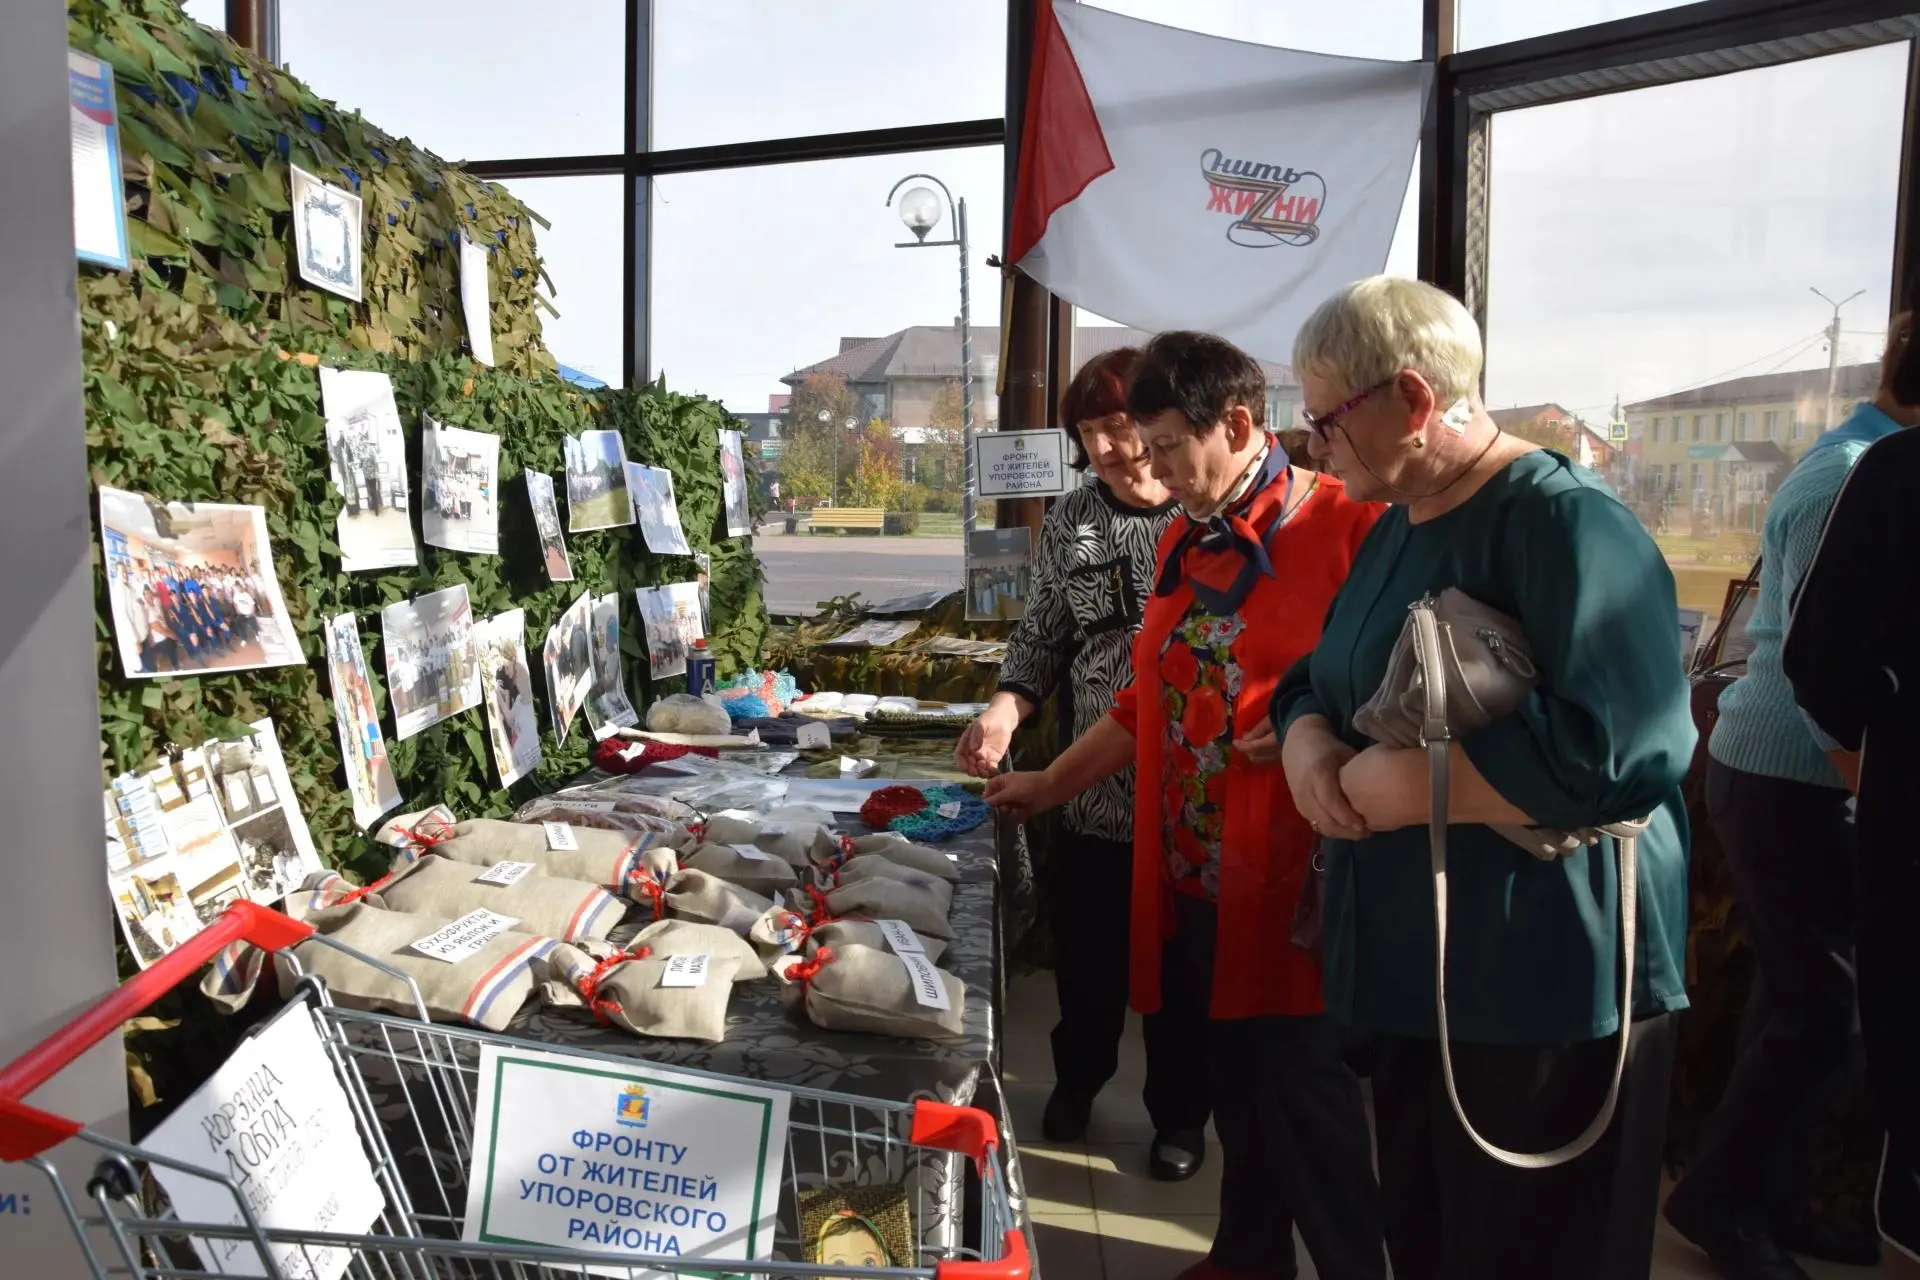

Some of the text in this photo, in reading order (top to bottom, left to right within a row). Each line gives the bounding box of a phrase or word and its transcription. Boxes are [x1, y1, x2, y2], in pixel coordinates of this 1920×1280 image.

[993, 461, 1050, 472] ОТ ЖИТЕЛЕЙ
[1002, 452, 1039, 461] ФРОНТУ
[989, 470, 1054, 481] УПОРОВСКОГО
[1006, 481, 1042, 490] РАЙОНА
[418, 910, 491, 950] СУХОФРУКТЫ
[437, 944, 457, 954] ИЗ
[454, 923, 491, 945] ЯБЛОК
[201, 1063, 283, 1153] КОРЗИНА
[225, 1098, 297, 1188] ДОБРА
[572, 1129, 688, 1165] ФРОНТУ
[537, 1153, 718, 1202] ОТ ЖИТЕЛЕЙ
[519, 1179, 727, 1234] УПОРОВСКОГО
[567, 1218, 682, 1256] РАЙОНА
